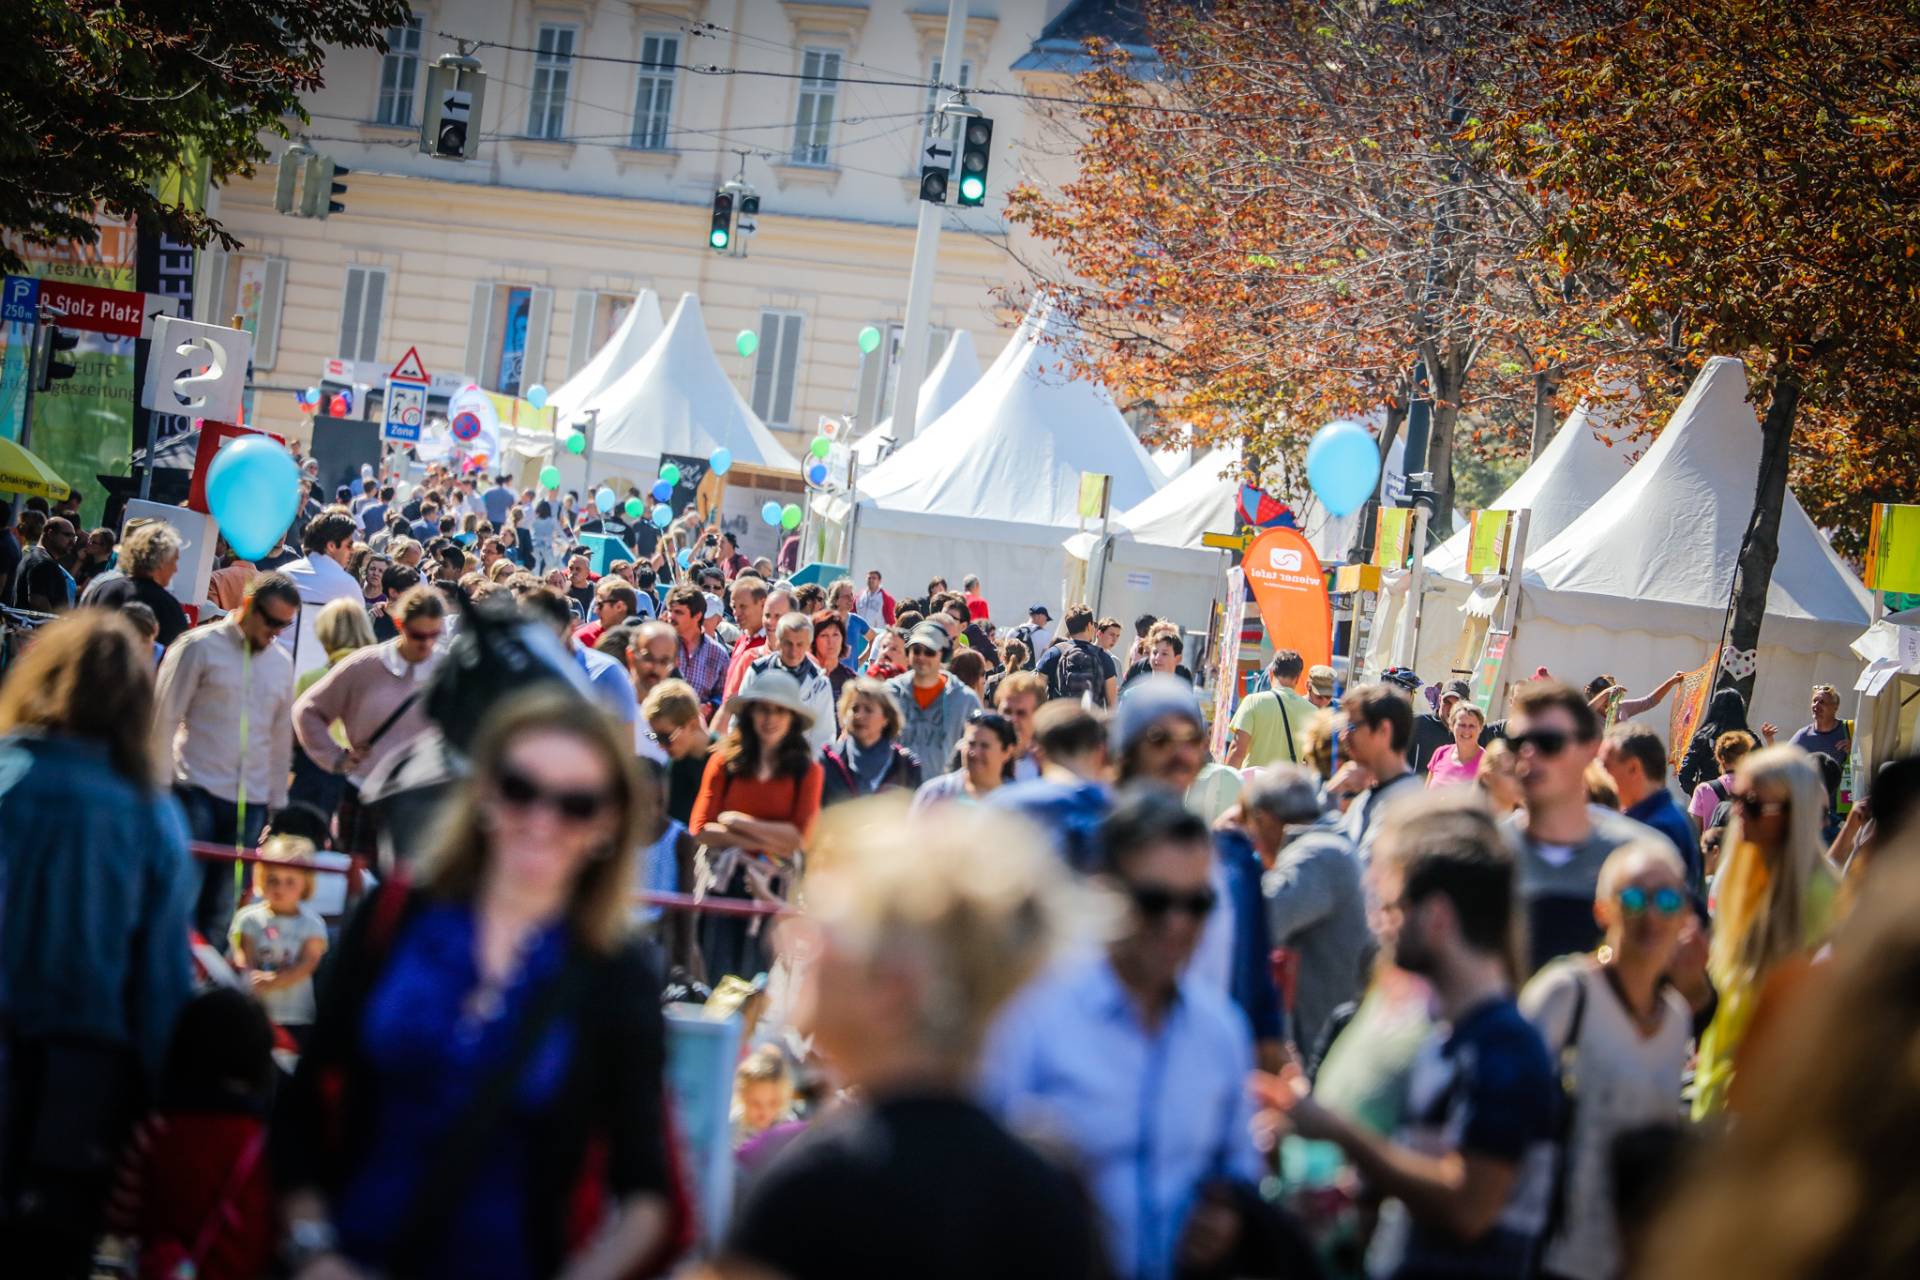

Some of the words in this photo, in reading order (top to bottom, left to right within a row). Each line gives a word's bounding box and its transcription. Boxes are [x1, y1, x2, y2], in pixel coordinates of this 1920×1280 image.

[56, 295, 95, 317] Stolz
[100, 300, 141, 323] Platz
[391, 424, 415, 438] Zone
